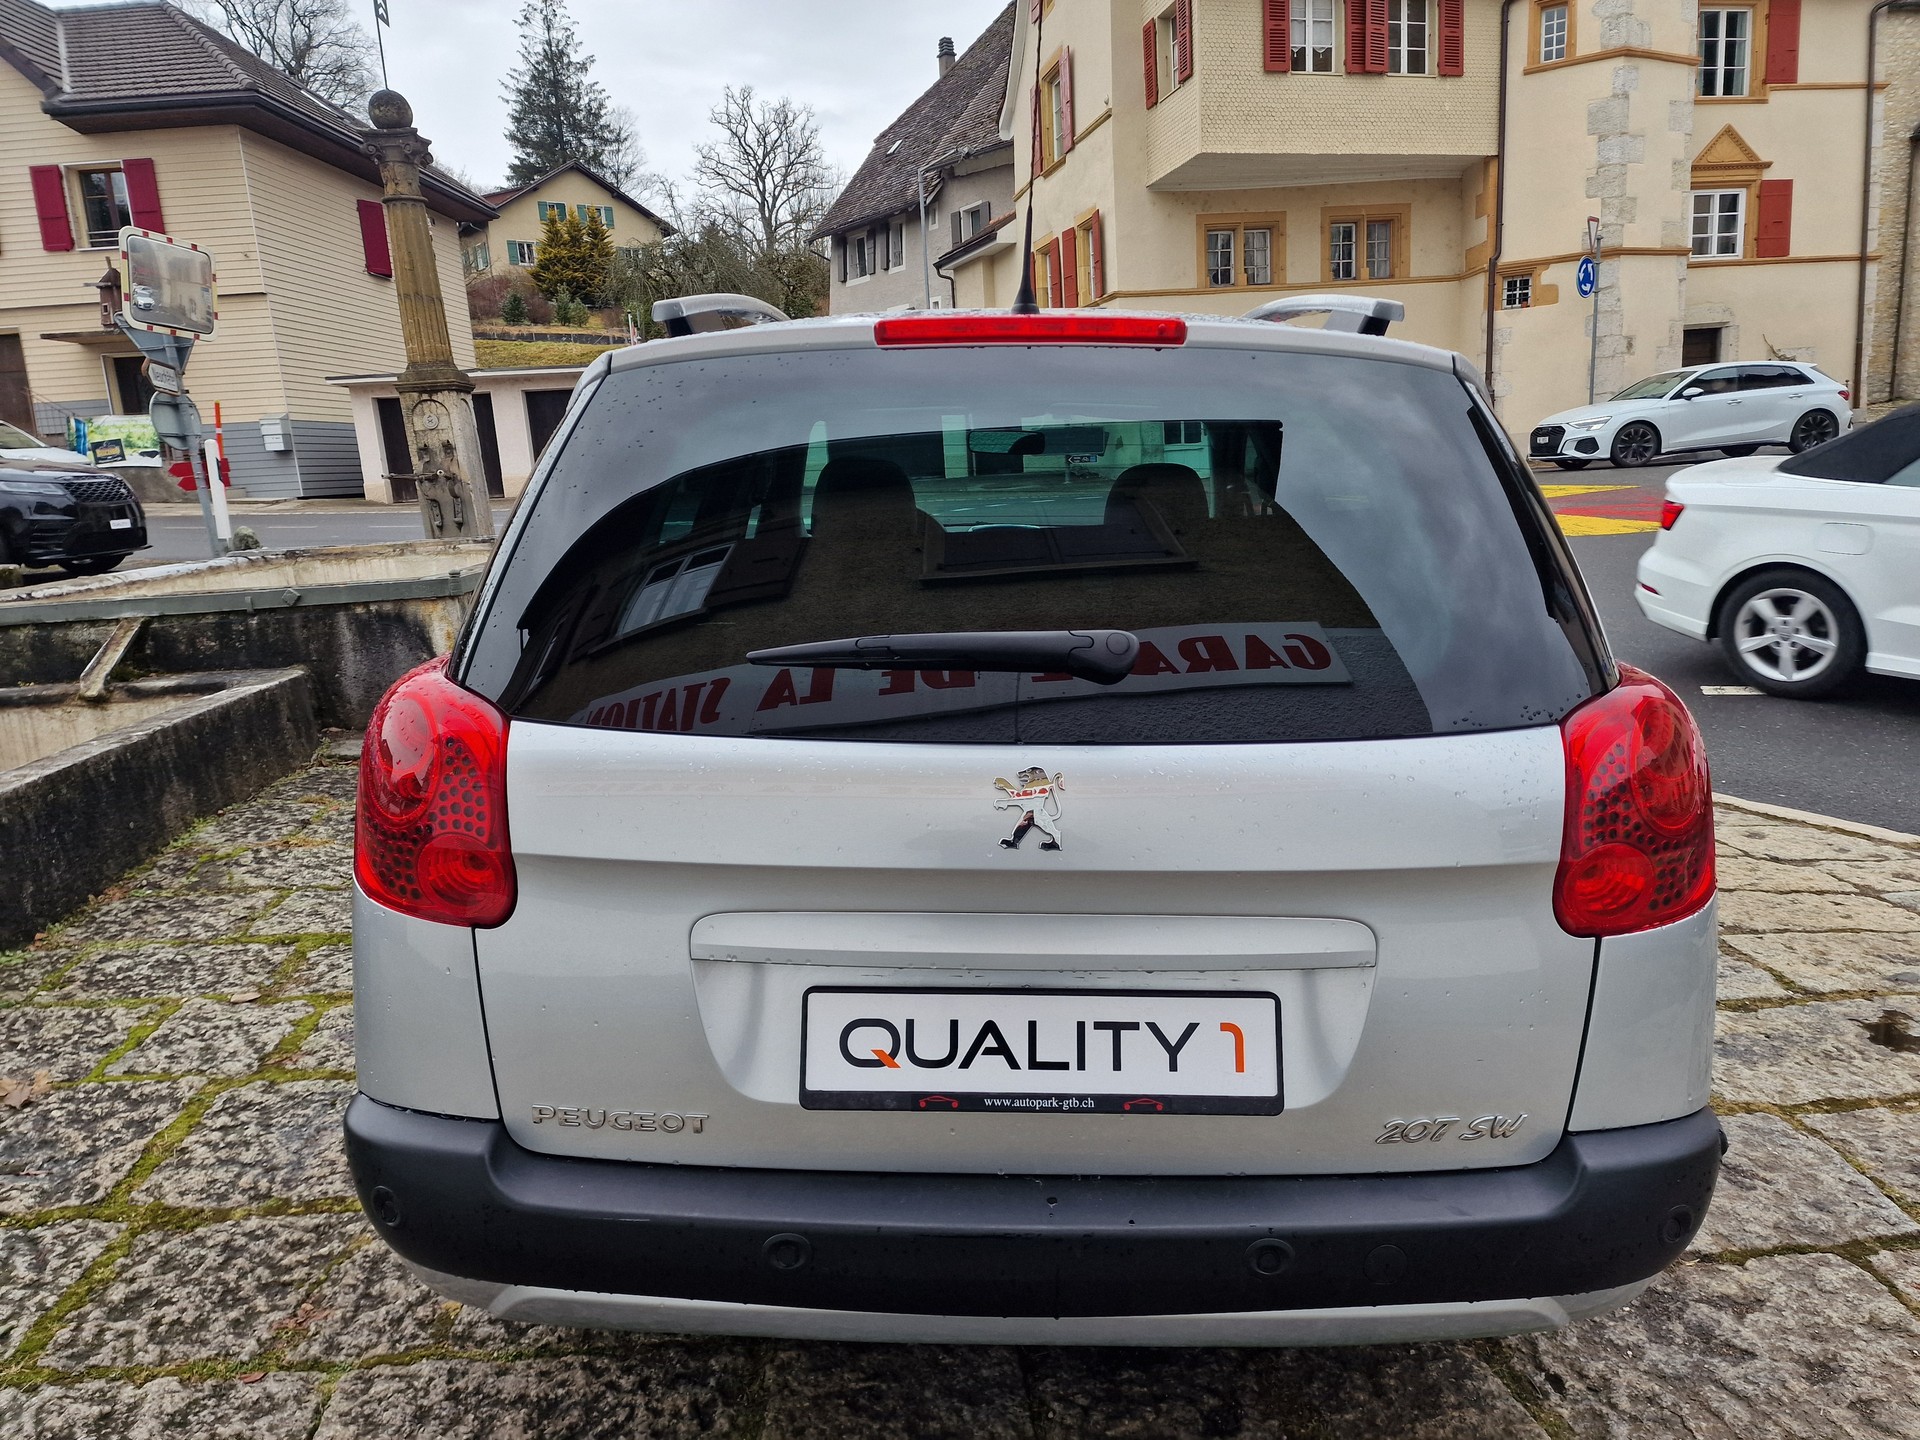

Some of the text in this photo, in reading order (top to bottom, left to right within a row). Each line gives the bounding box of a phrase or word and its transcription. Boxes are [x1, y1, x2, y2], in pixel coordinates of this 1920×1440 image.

[838, 1017, 1245, 1073] QUALITY 1
[531, 1103, 710, 1135] PEUGEOT
[984, 1096, 1095, 1110] www.autopark-gtb.ch
[1375, 1113, 1529, 1145] 207 SW
